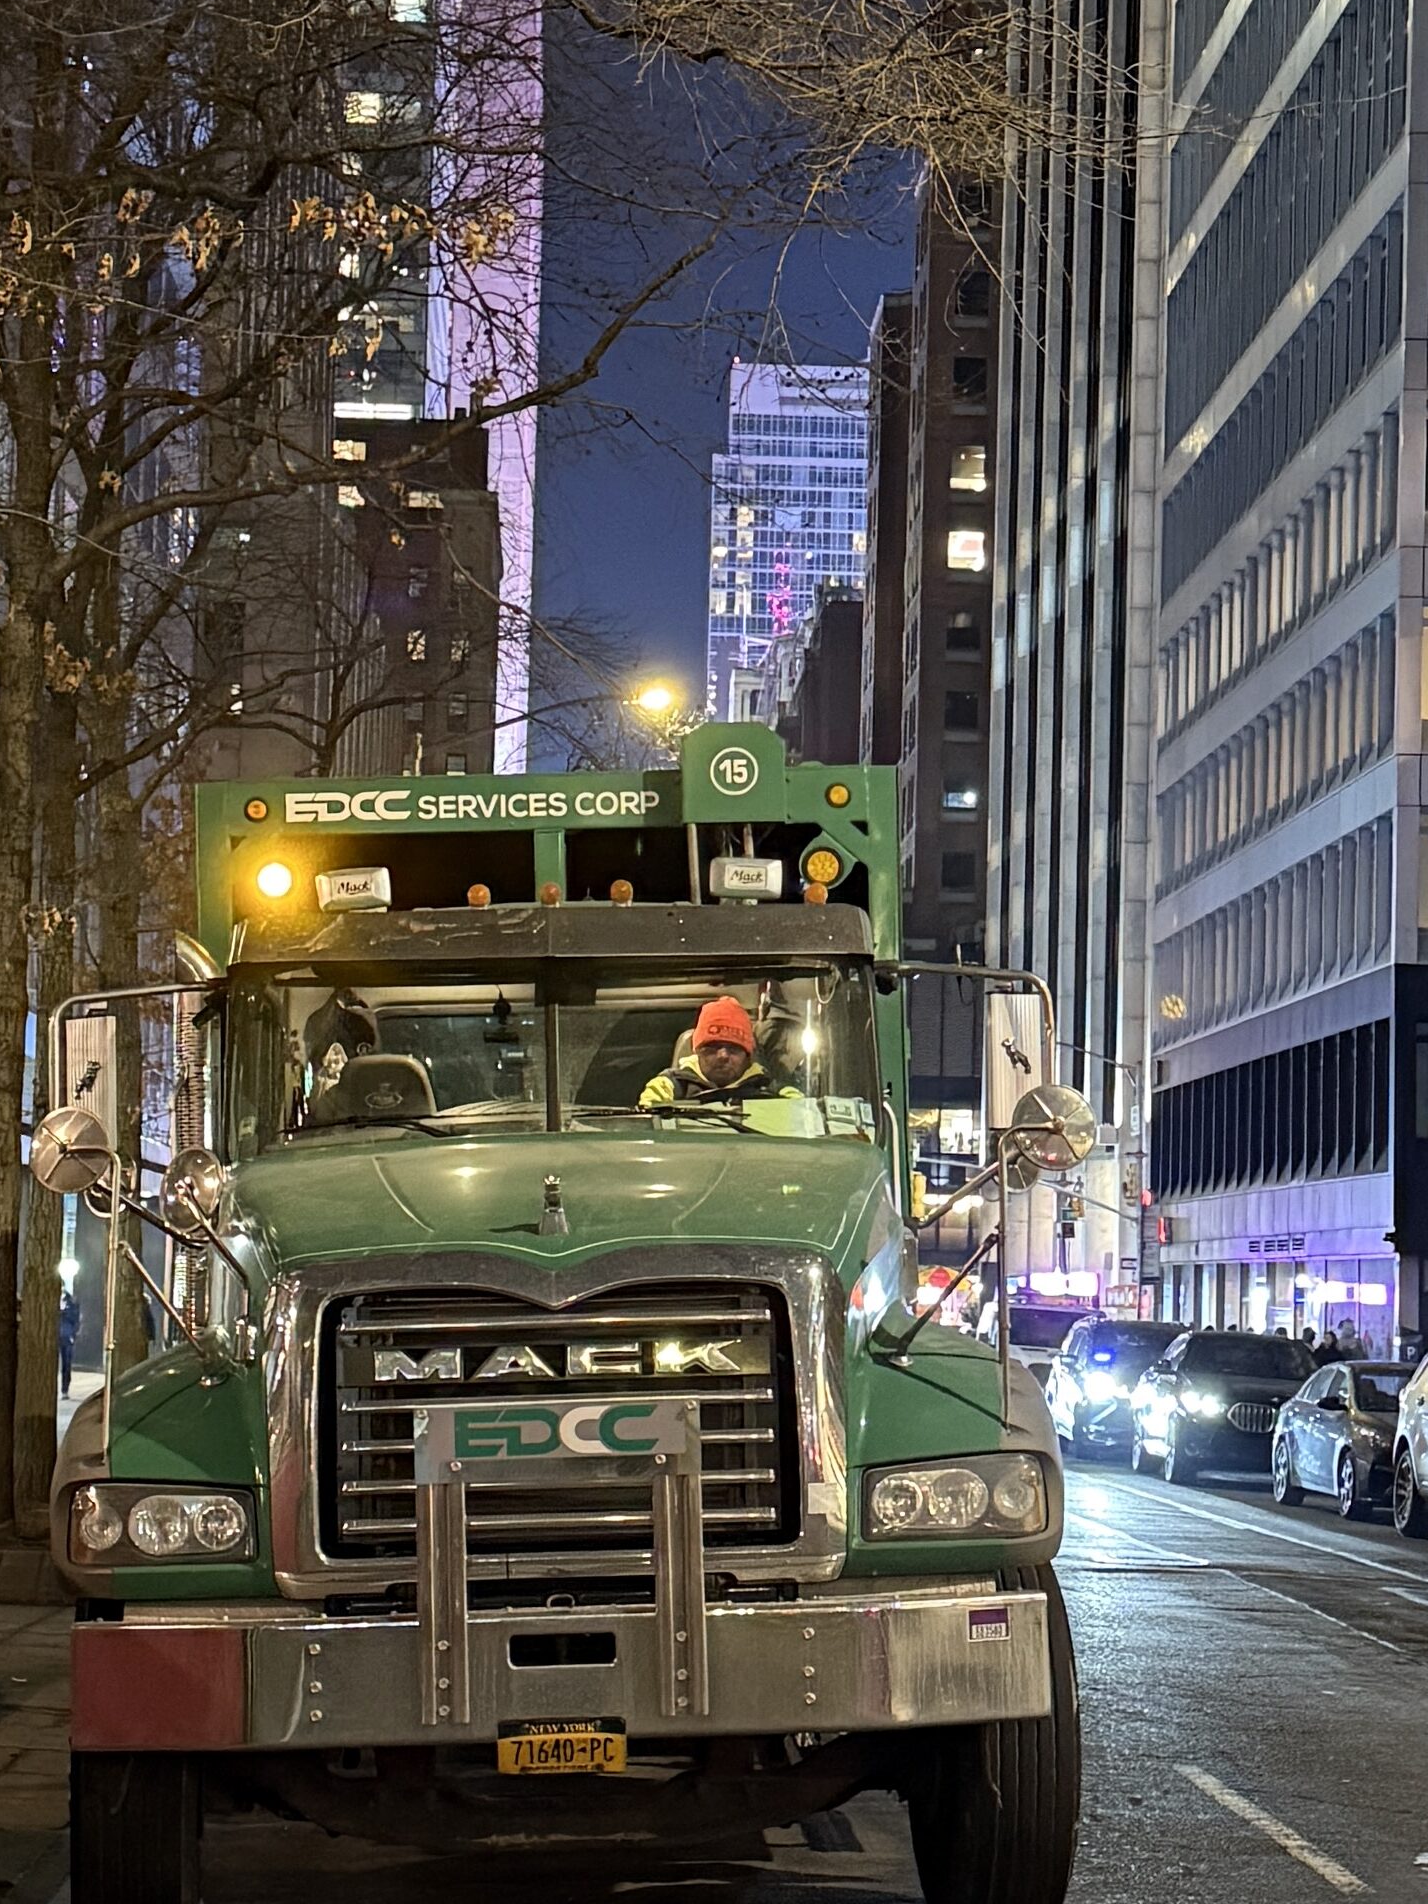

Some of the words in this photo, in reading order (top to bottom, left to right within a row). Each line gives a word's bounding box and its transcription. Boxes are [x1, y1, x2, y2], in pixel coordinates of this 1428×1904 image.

[719, 759, 748, 784] 15
[285, 790, 411, 823] EDCC
[418, 793, 568, 820] SERVICES
[574, 791, 660, 817] CORP
[337, 880, 371, 895] Mack
[730, 869, 765, 884] Mack
[374, 1339, 742, 1381] MACK
[454, 1404, 660, 1458] EDCC
[529, 1723, 560, 1735] NEW
[562, 1722, 596, 1734] YORK
